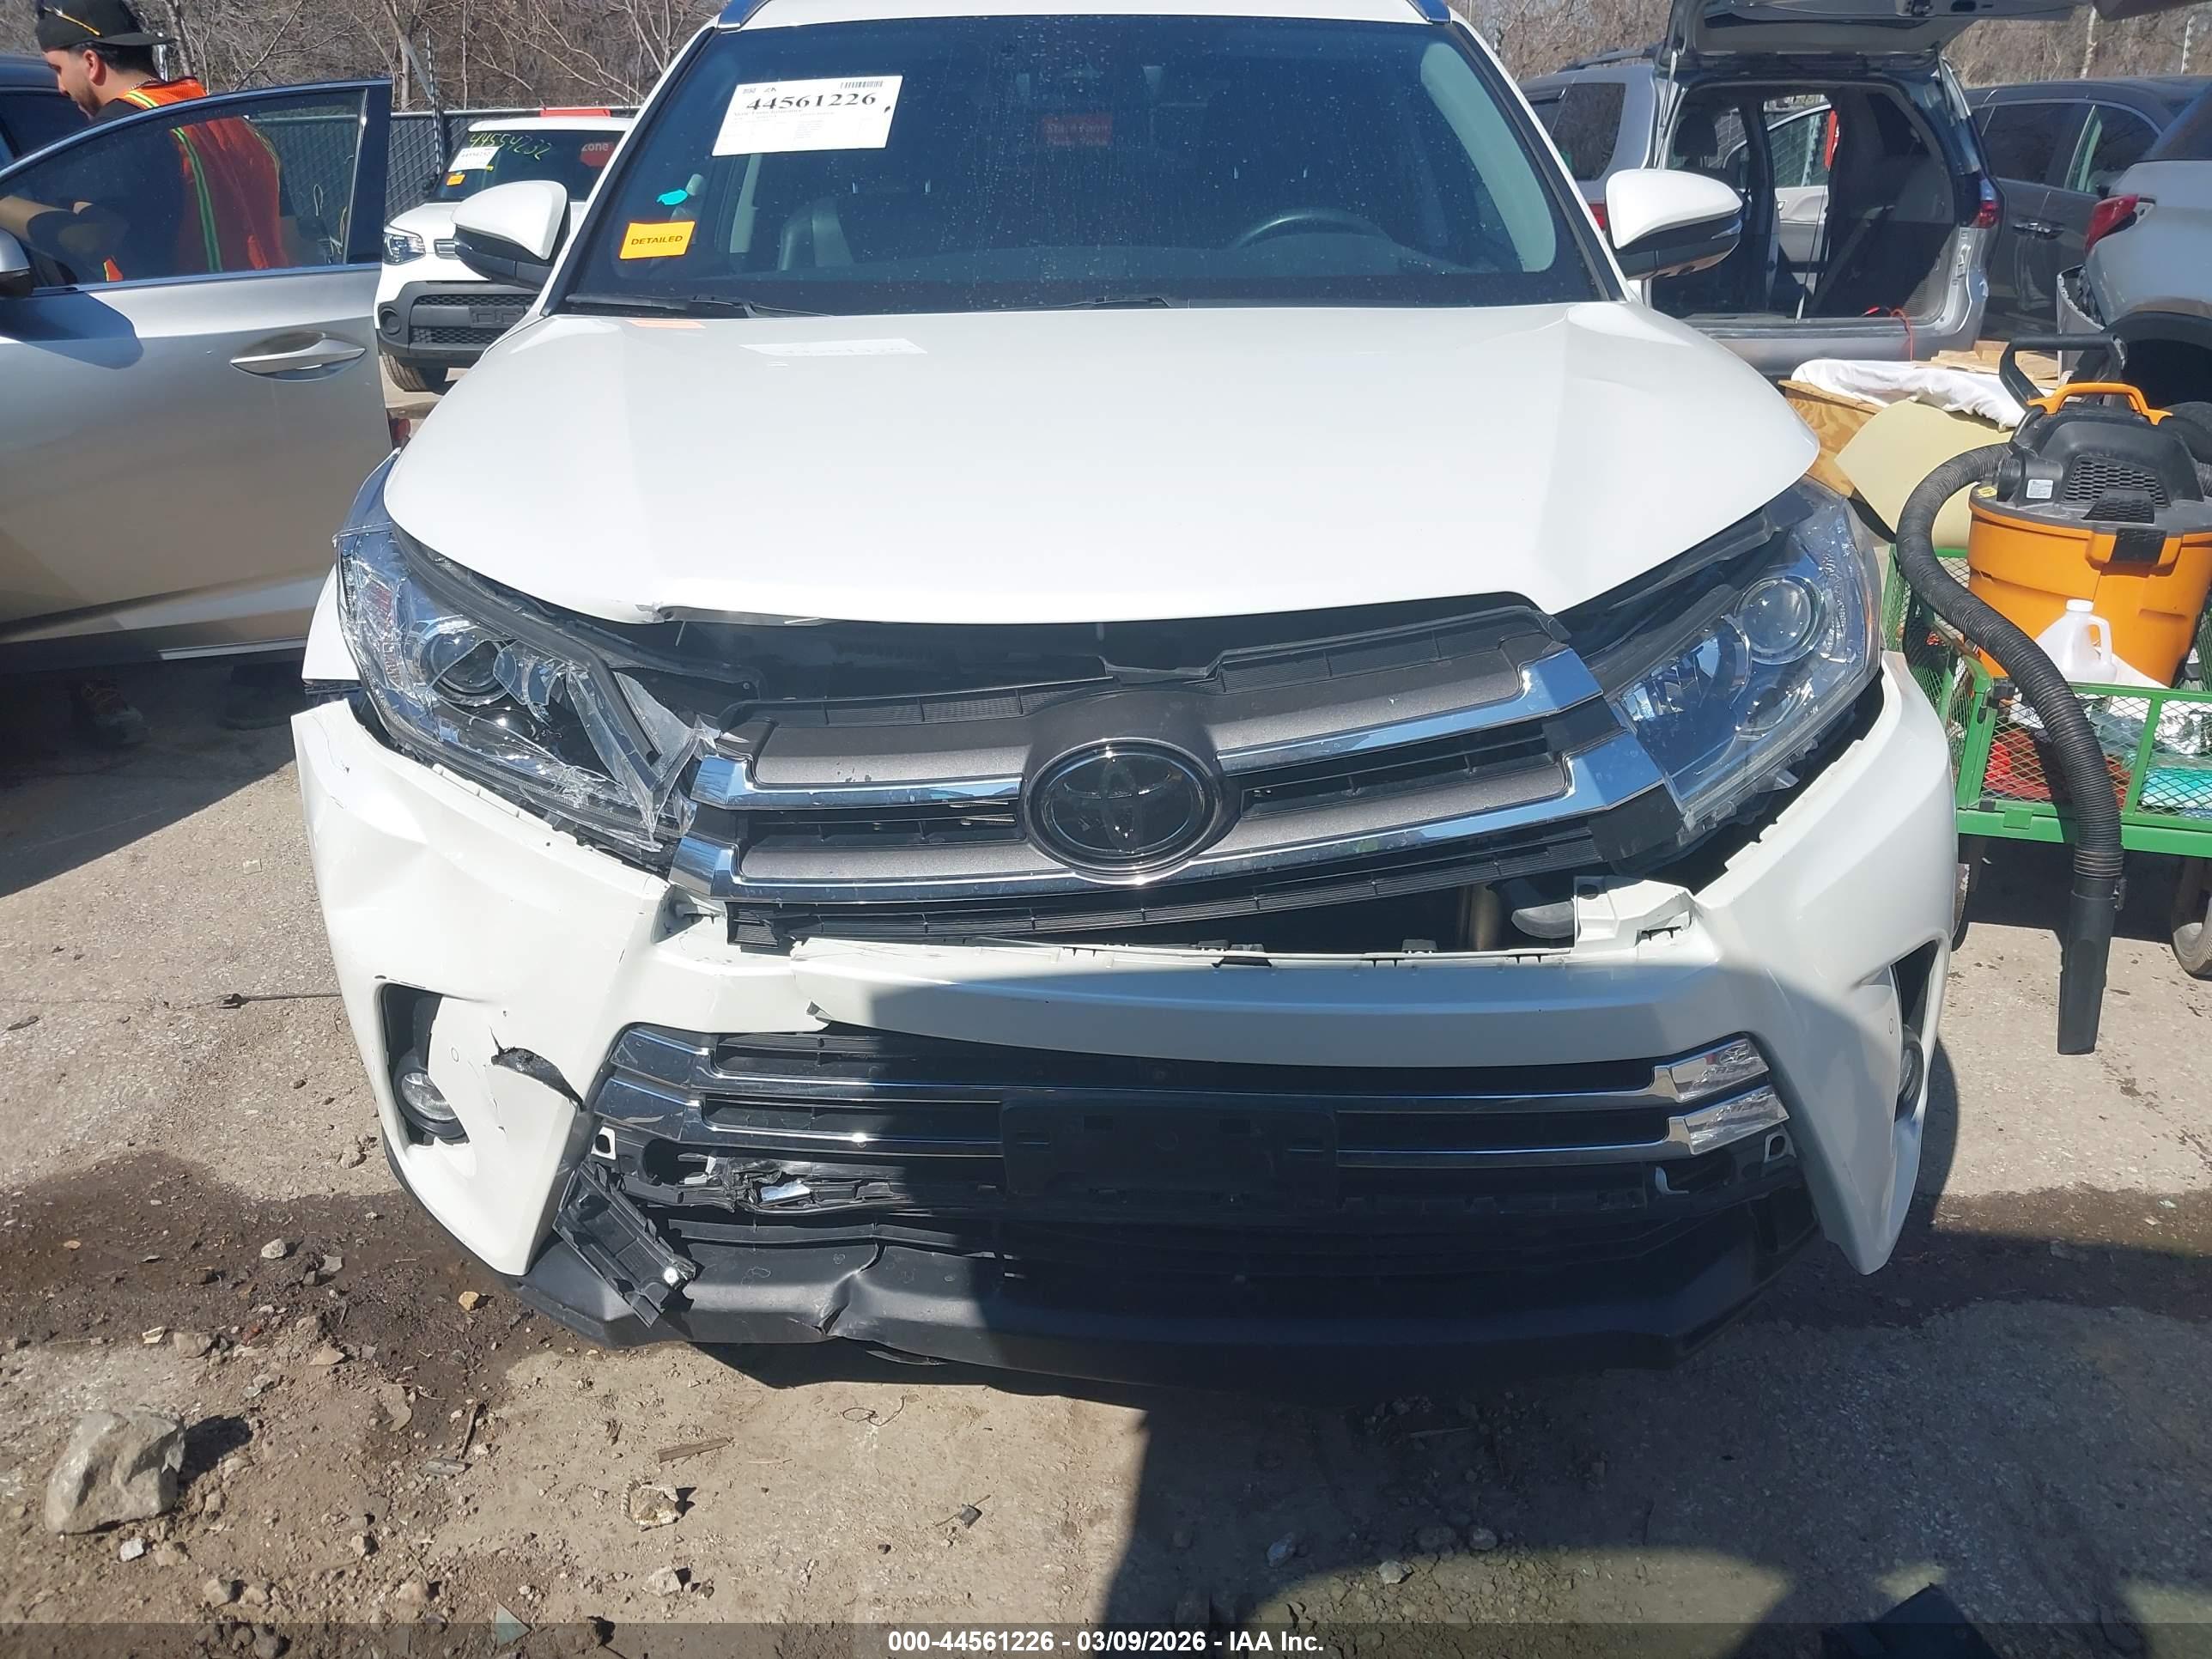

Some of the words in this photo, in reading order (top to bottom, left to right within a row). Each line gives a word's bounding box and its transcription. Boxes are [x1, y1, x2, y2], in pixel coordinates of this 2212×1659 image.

[746, 92, 878, 110] 44561226
[469, 132, 552, 161] 44554232
[630, 235, 684, 246] DETAILED
